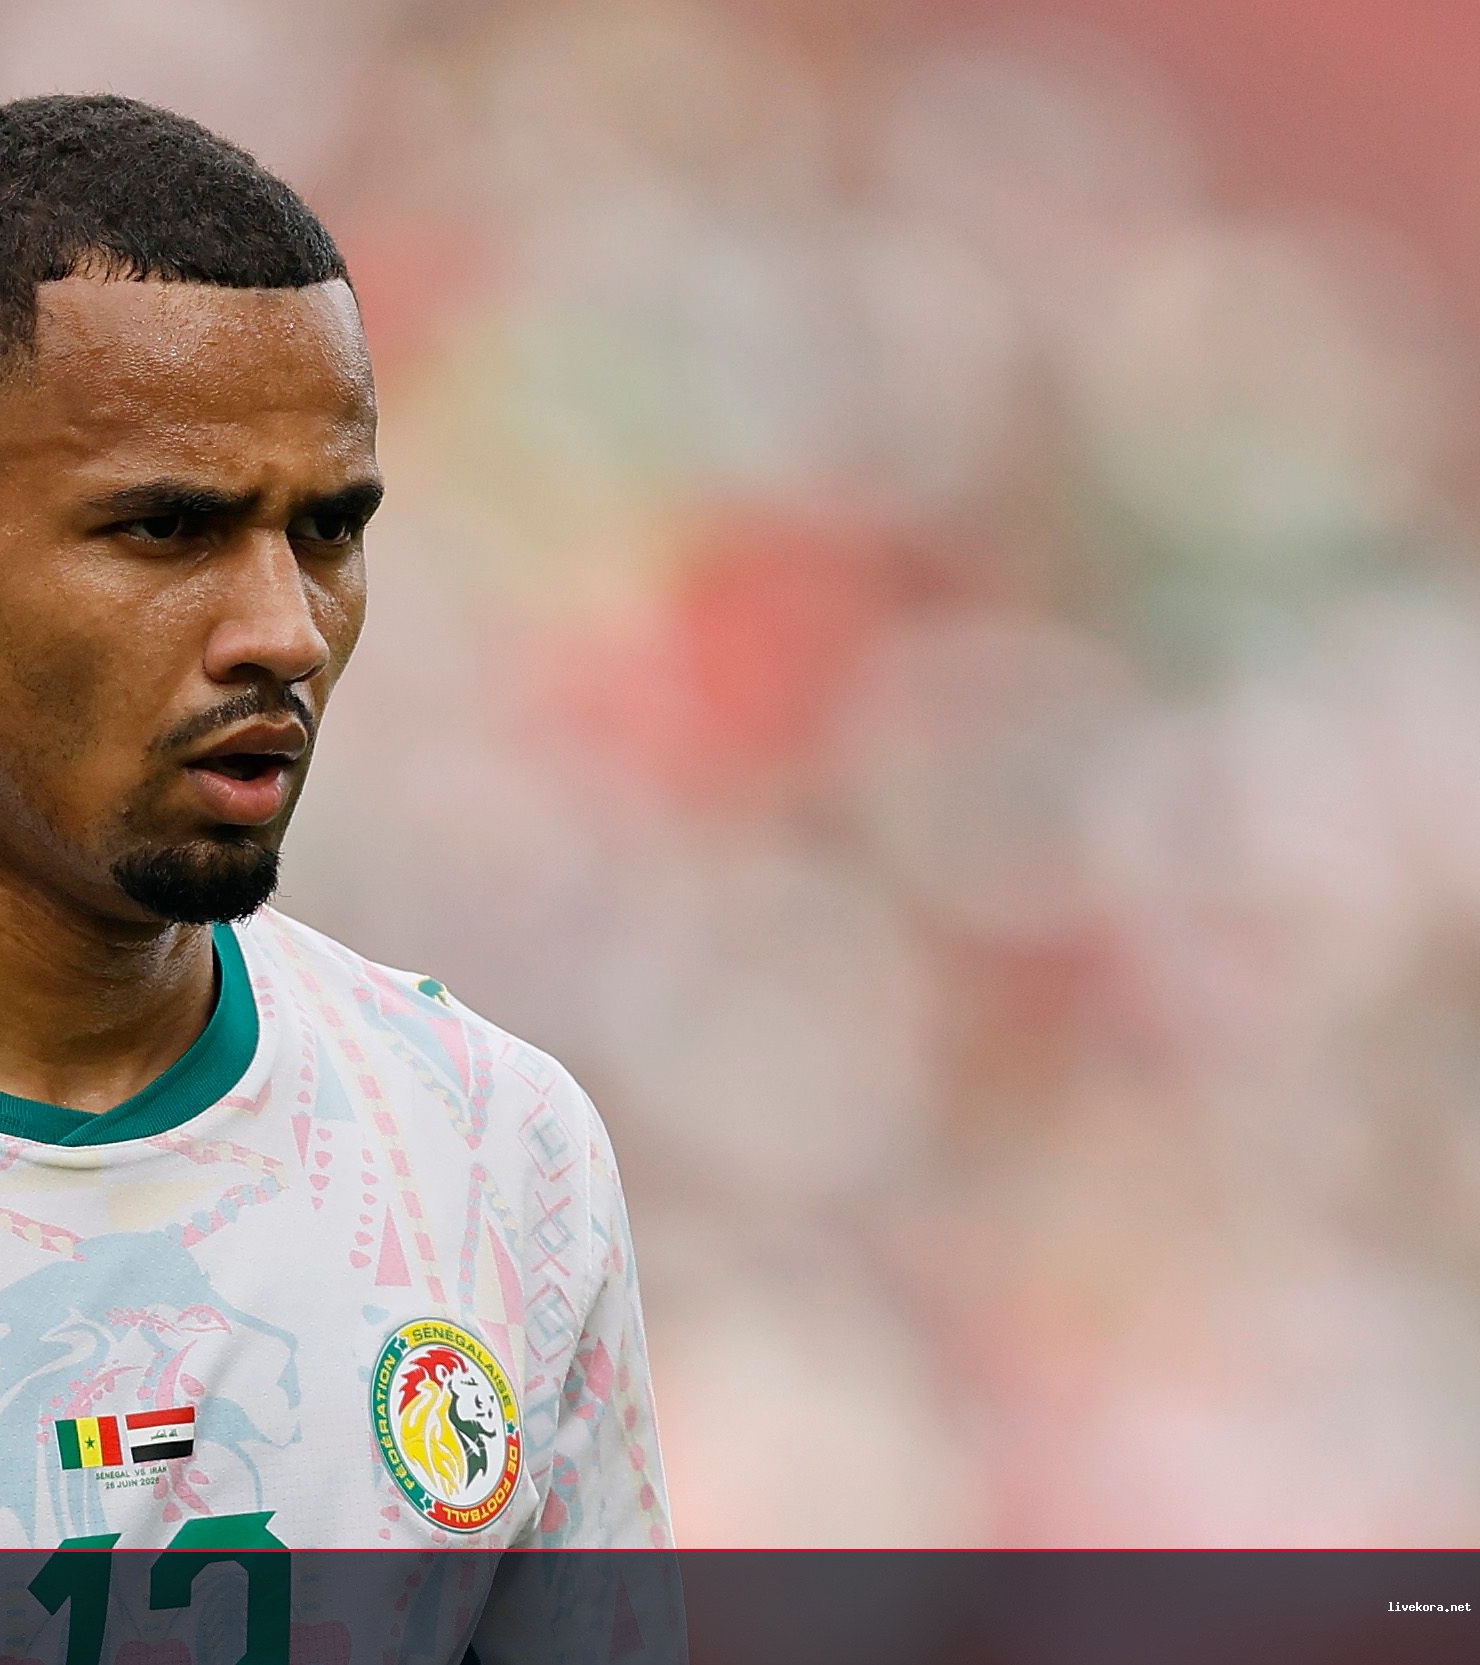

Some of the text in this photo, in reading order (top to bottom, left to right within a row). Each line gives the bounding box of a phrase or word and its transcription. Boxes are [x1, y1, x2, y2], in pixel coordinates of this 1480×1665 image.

[507, 1444, 519, 1473] DE
[117, 1479, 138, 1489] JUIN
[442, 1476, 512, 1524] FOOTBALL
